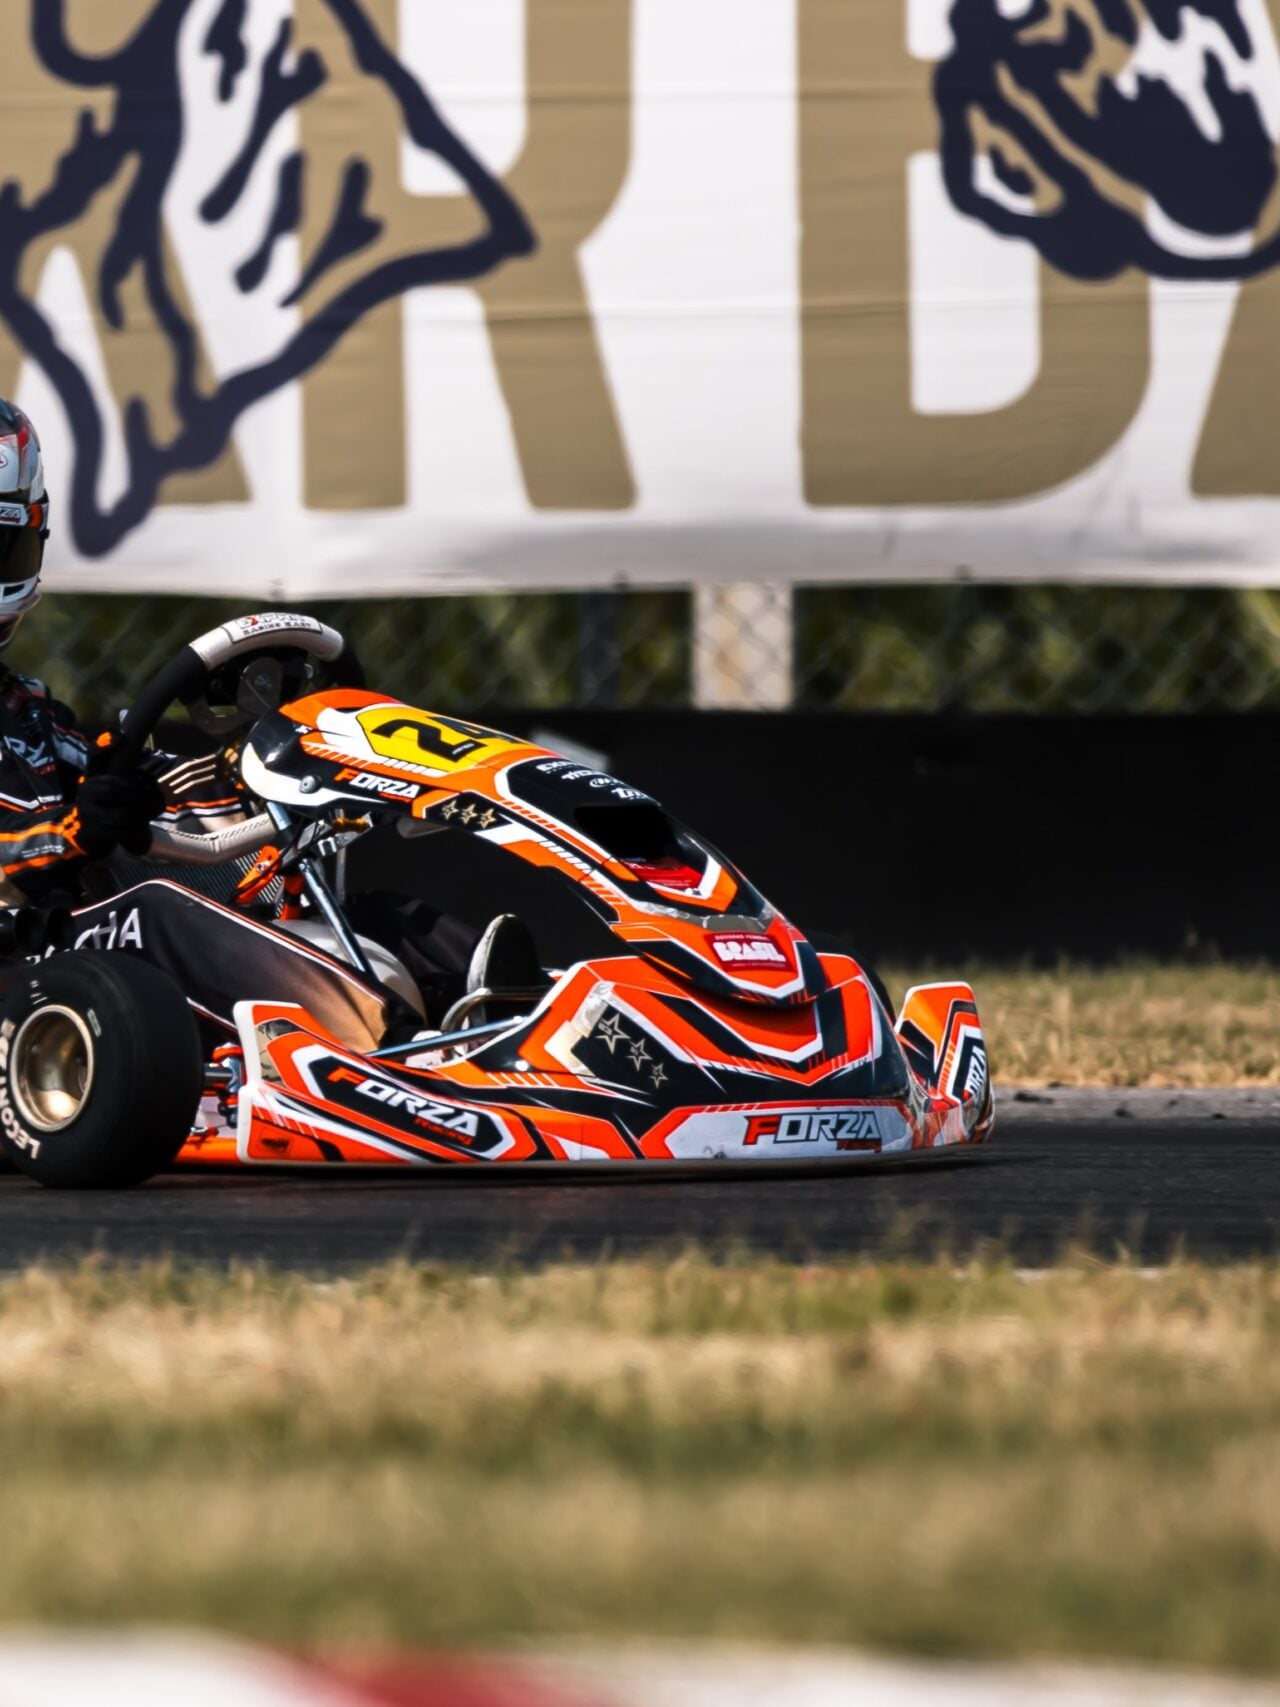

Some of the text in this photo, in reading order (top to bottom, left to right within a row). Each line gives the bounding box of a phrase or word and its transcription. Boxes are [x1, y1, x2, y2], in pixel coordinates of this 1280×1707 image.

[333, 768, 421, 799] FORZA
[712, 941, 787, 962] BRASIL
[326, 1066, 479, 1137] FORZA
[742, 1110, 883, 1146] FORZA
